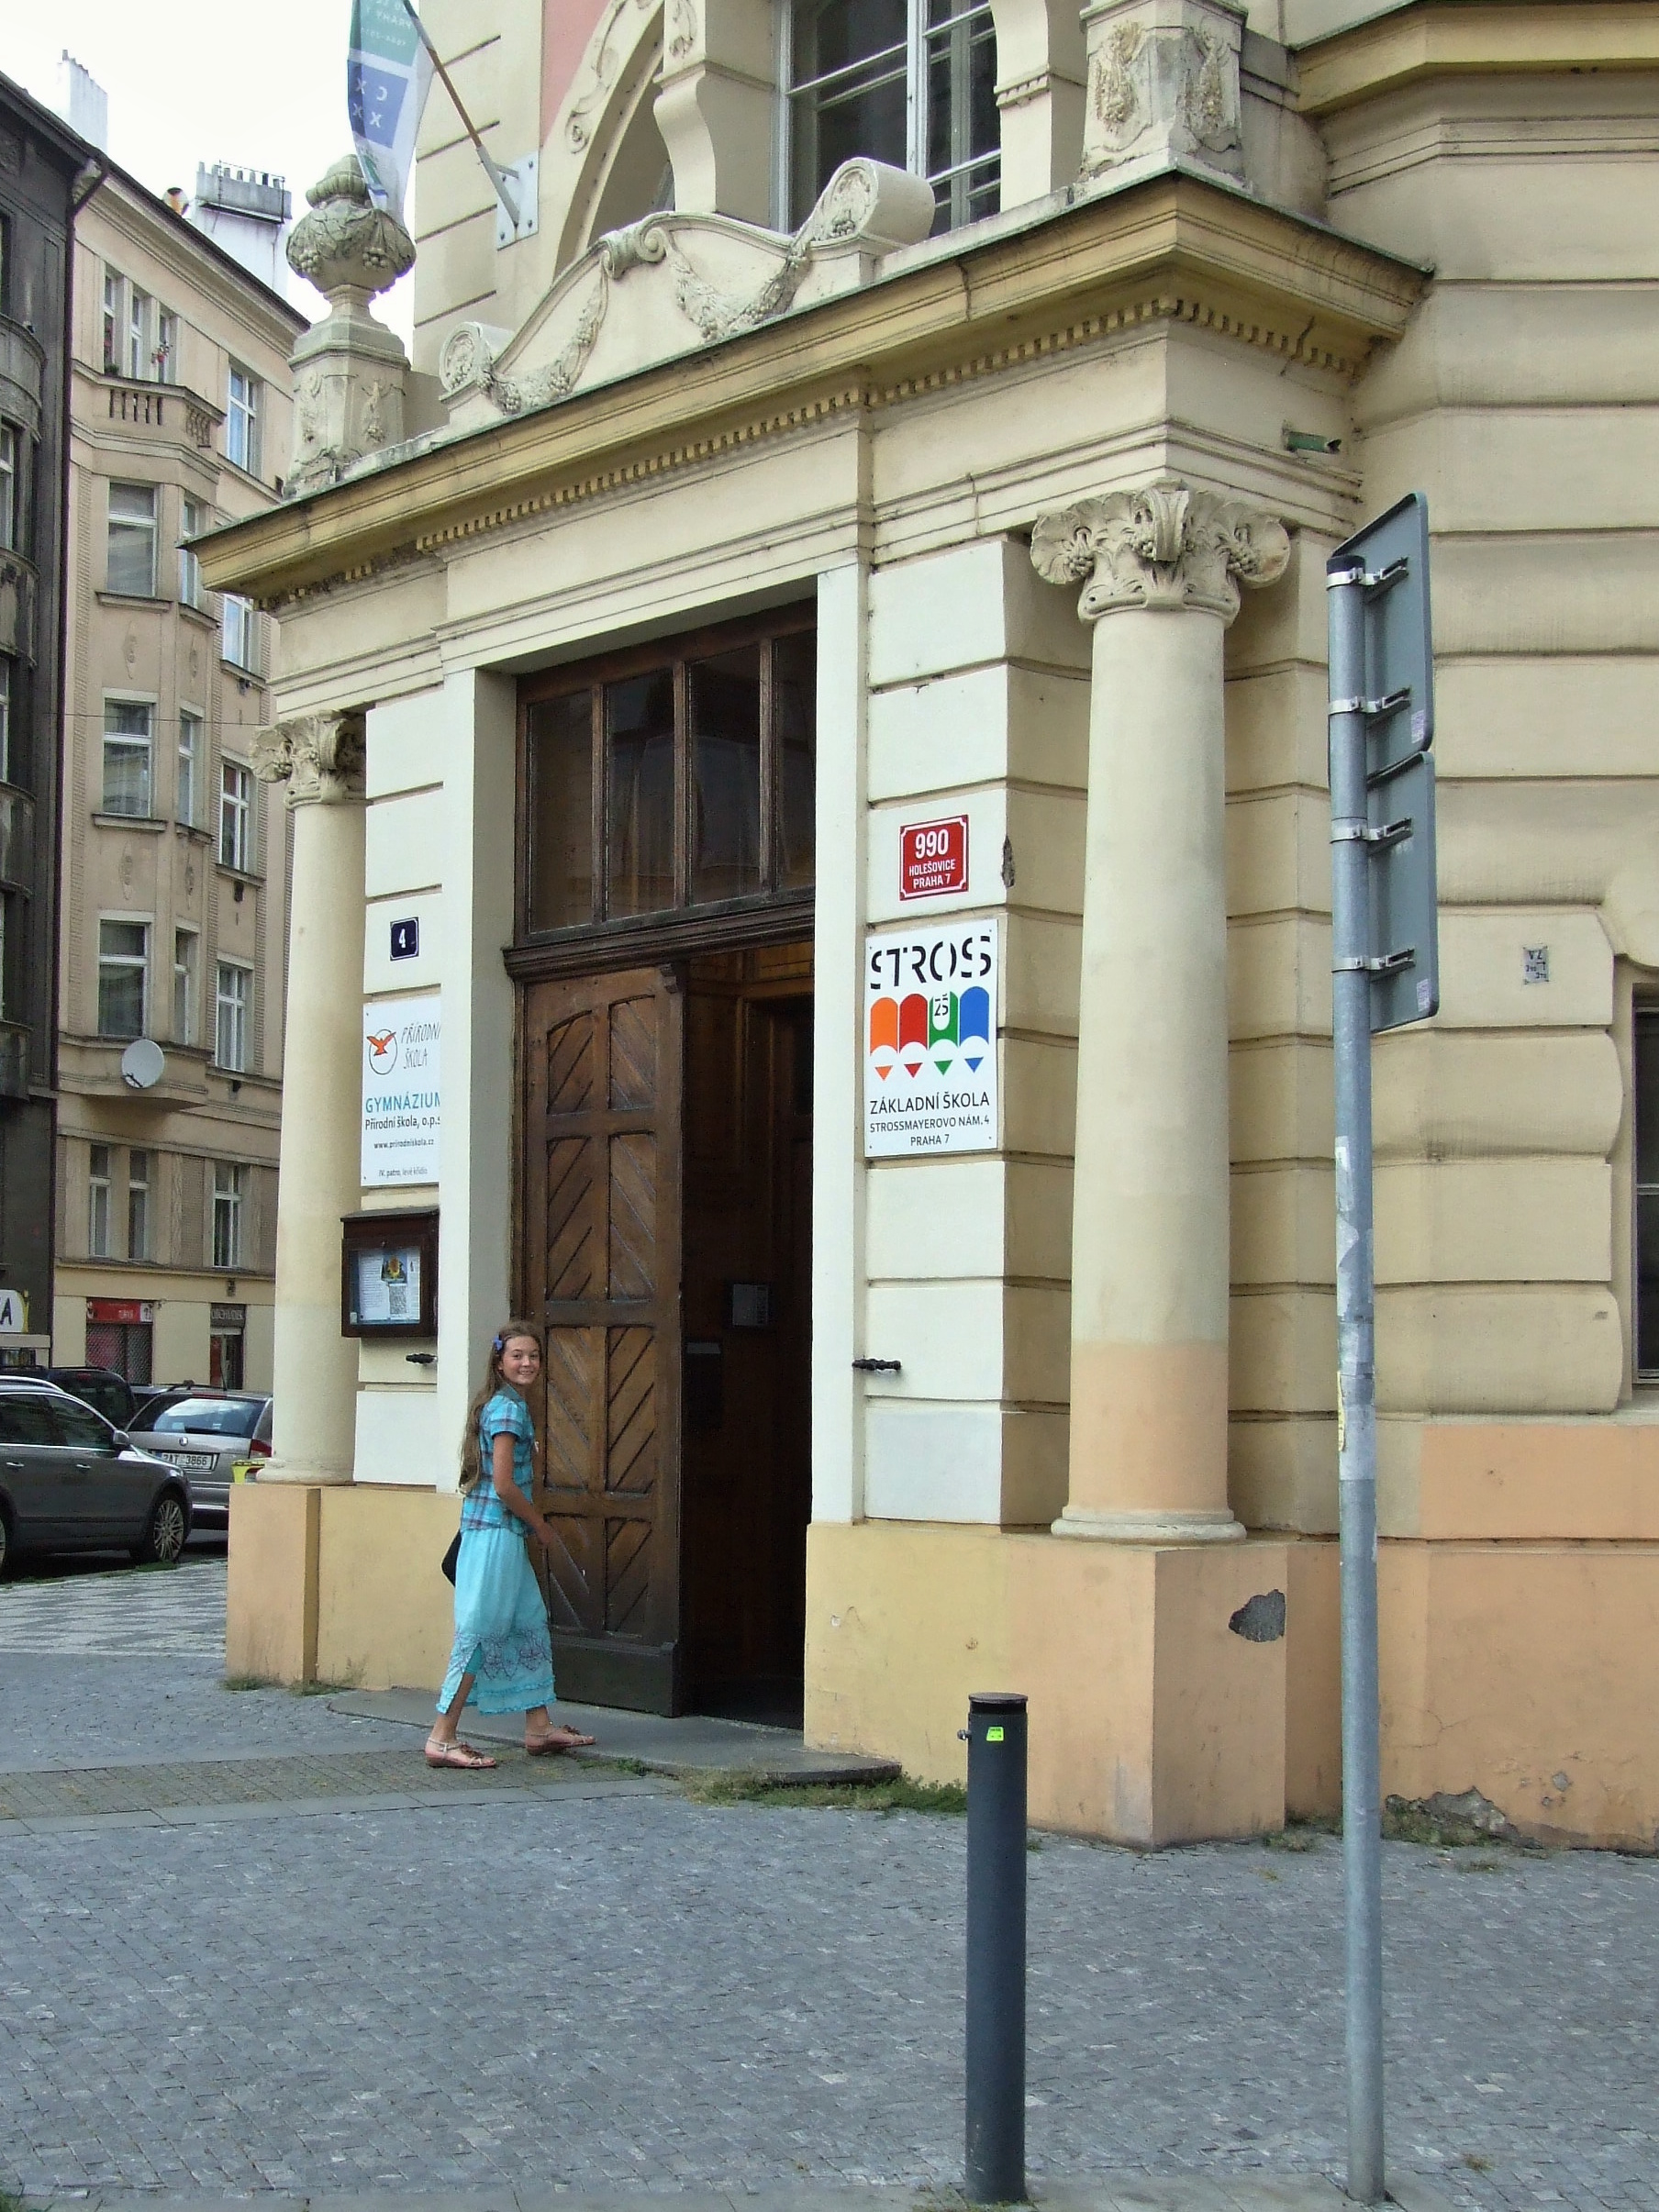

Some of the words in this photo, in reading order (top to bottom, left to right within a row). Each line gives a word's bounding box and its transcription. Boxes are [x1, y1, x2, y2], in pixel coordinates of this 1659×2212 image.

[915, 829, 949, 859] 990
[909, 860, 956, 876] HOLEŠOVICE
[913, 875, 943, 889] PRAHA
[945, 873, 952, 884] 7
[398, 928, 406, 948] 4
[870, 936, 992, 989] STROS
[934, 994, 949, 1017] ZŠ
[404, 1048, 428, 1069] ŠKOLA
[870, 1092, 940, 1115] ZÁKLADNÍ
[942, 1091, 990, 1109] ŠKOLA
[870, 1117, 956, 1133] STROSSMAYEROVO
[958, 1115, 983, 1126] NÁM.
[984, 1114, 990, 1125] 4
[910, 1136, 941, 1147] PRAHA
[944, 1134, 950, 1144] 7
[0, 1296, 12, 1326] A
